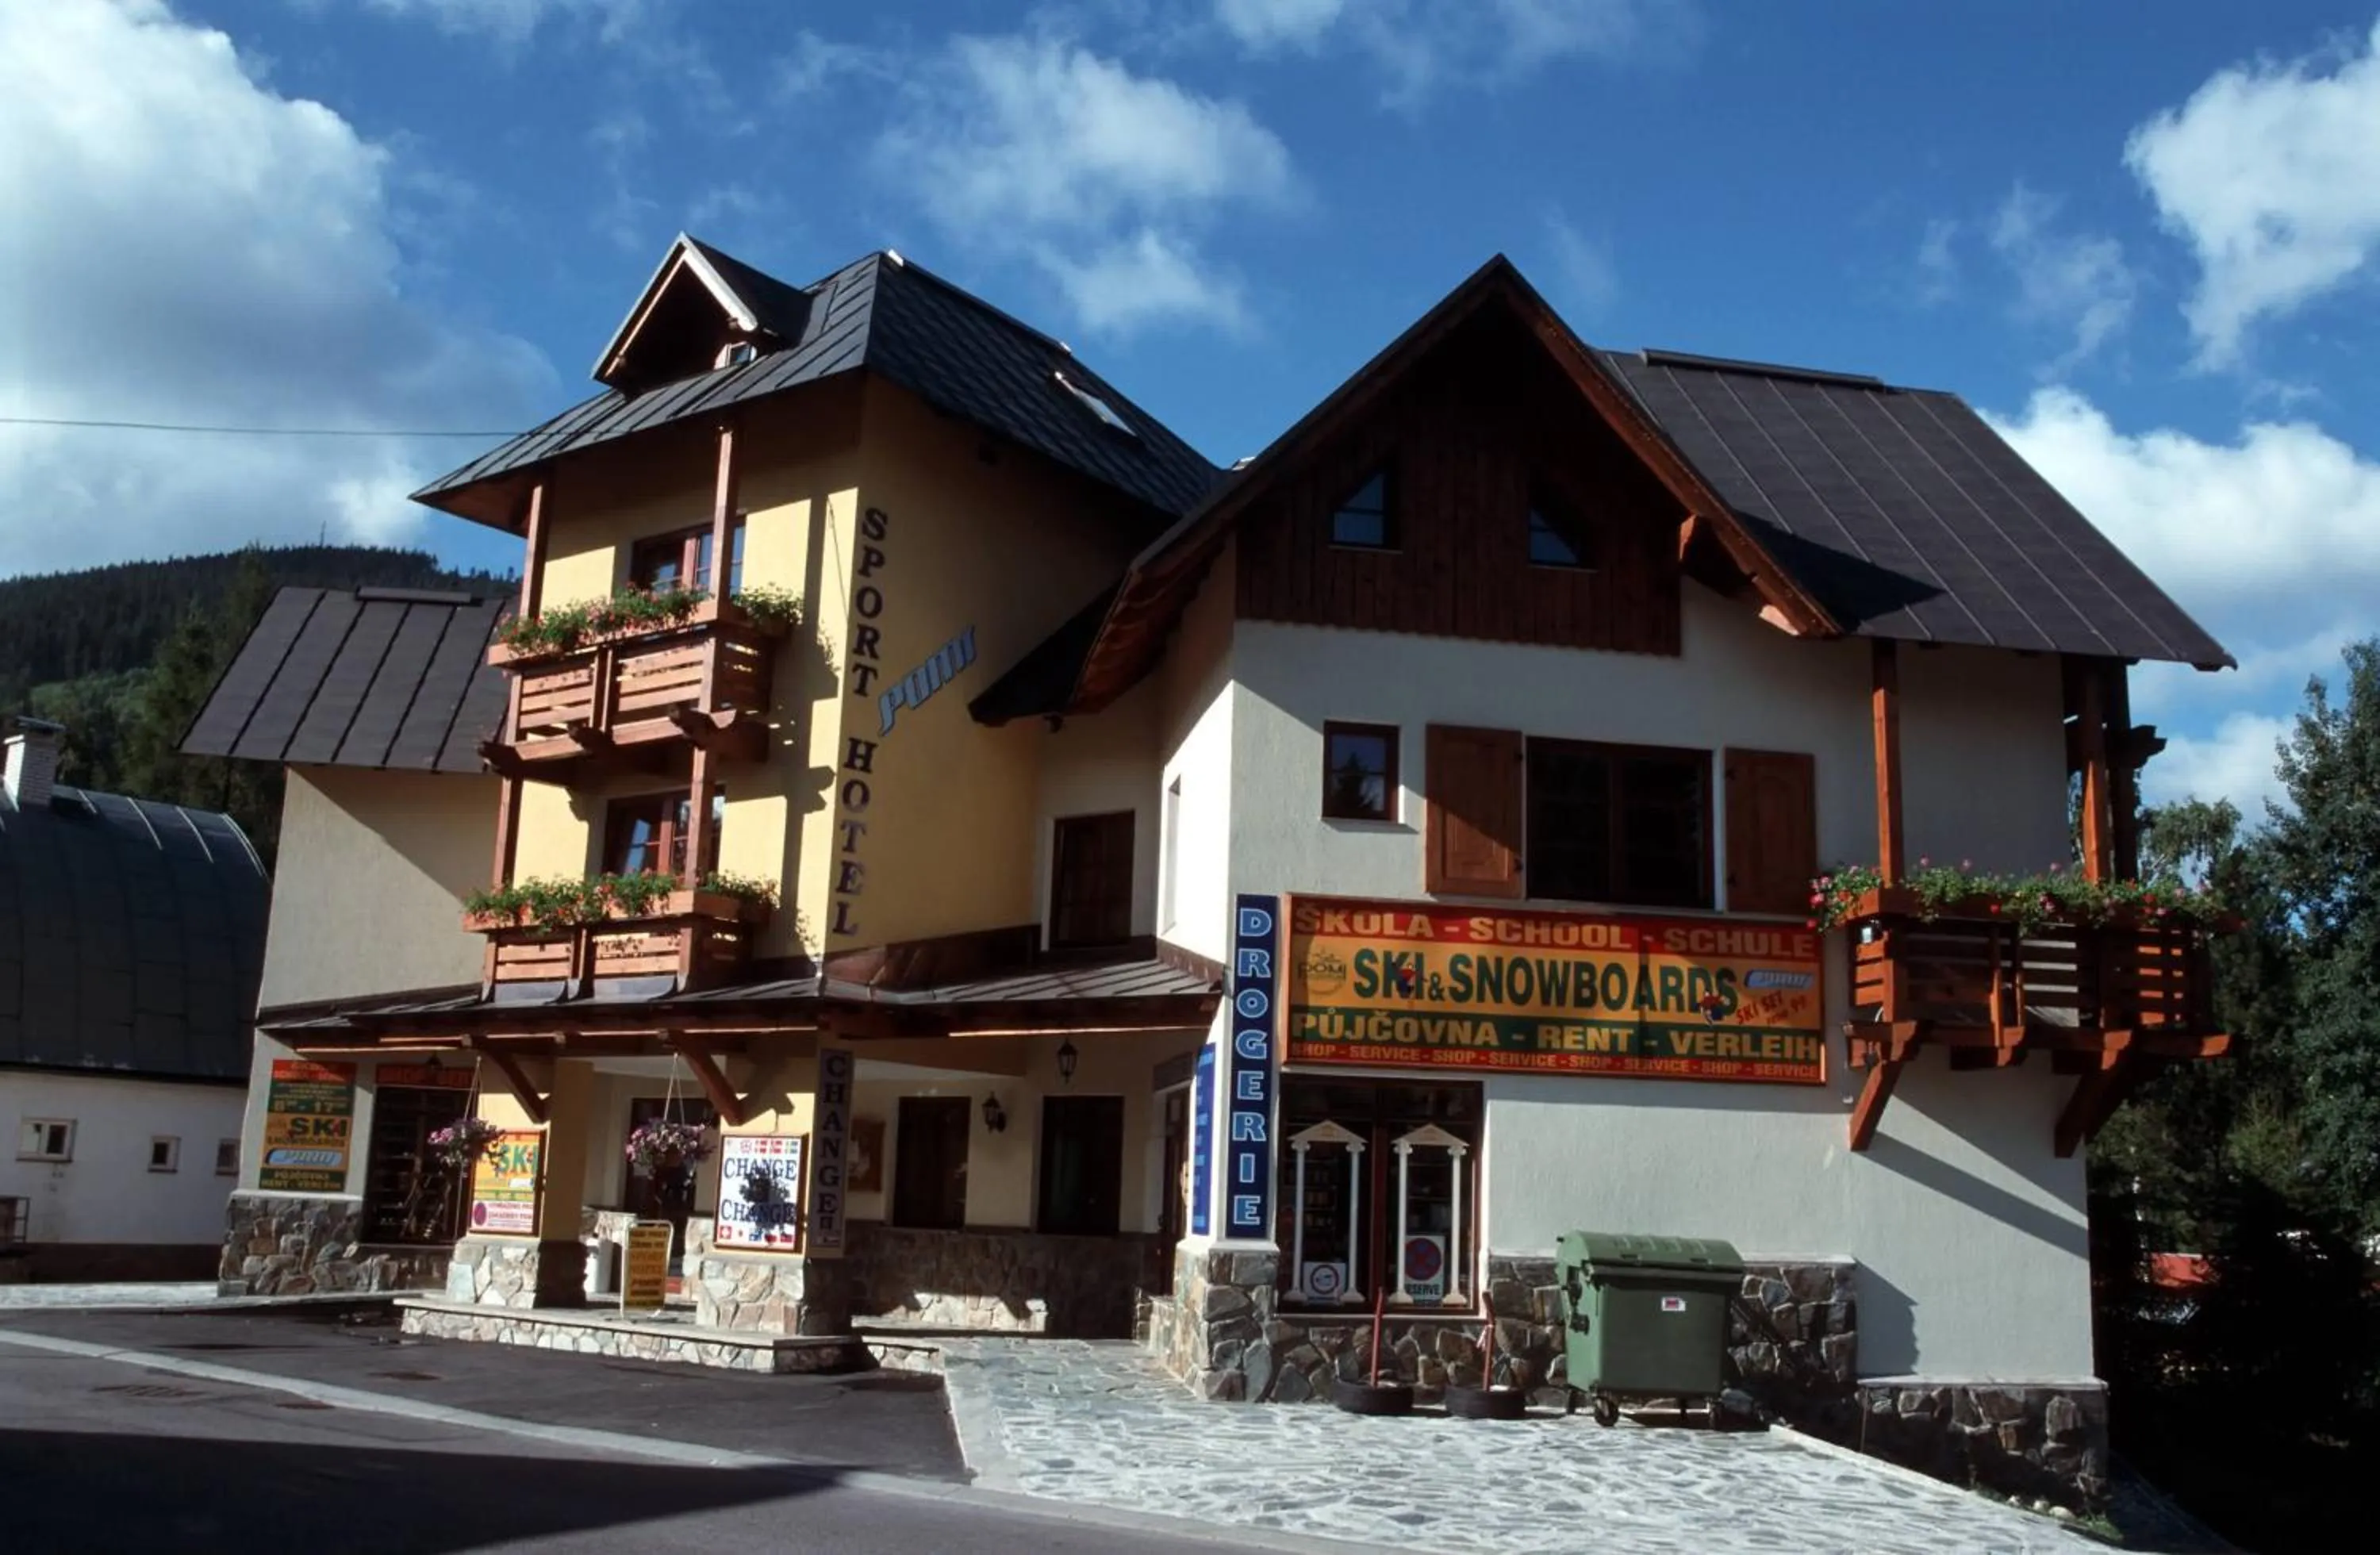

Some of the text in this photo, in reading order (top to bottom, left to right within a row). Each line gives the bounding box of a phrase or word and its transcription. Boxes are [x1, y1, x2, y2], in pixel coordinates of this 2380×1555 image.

[832, 508, 888, 936] SPORT HOTEL
[1469, 917, 1632, 948] SCHOOL
[1664, 927, 1814, 957] SCHULE
[1292, 1008, 1499, 1046] PŮJČOVNA
[1537, 1024, 1634, 1052] RENT
[1669, 1031, 1818, 1060] VERLEIH
[1232, 908, 1272, 1225] DROGERIE
[1292, 1043, 1336, 1056] SHOP
[1349, 1046, 1420, 1061] SERVICE
[1432, 1050, 1476, 1063] SHOP
[1488, 1052, 1557, 1067] SERVICE
[1568, 1054, 1611, 1069] SHOP
[1624, 1058, 1690, 1073] SERVICE
[1702, 1061, 1742, 1074] SHOP
[1753, 1063, 1818, 1077] SERVICE
[290, 1117, 347, 1138] SKI
[816, 1054, 846, 1214] CHANGE
[724, 1158, 797, 1181] CHANGE
